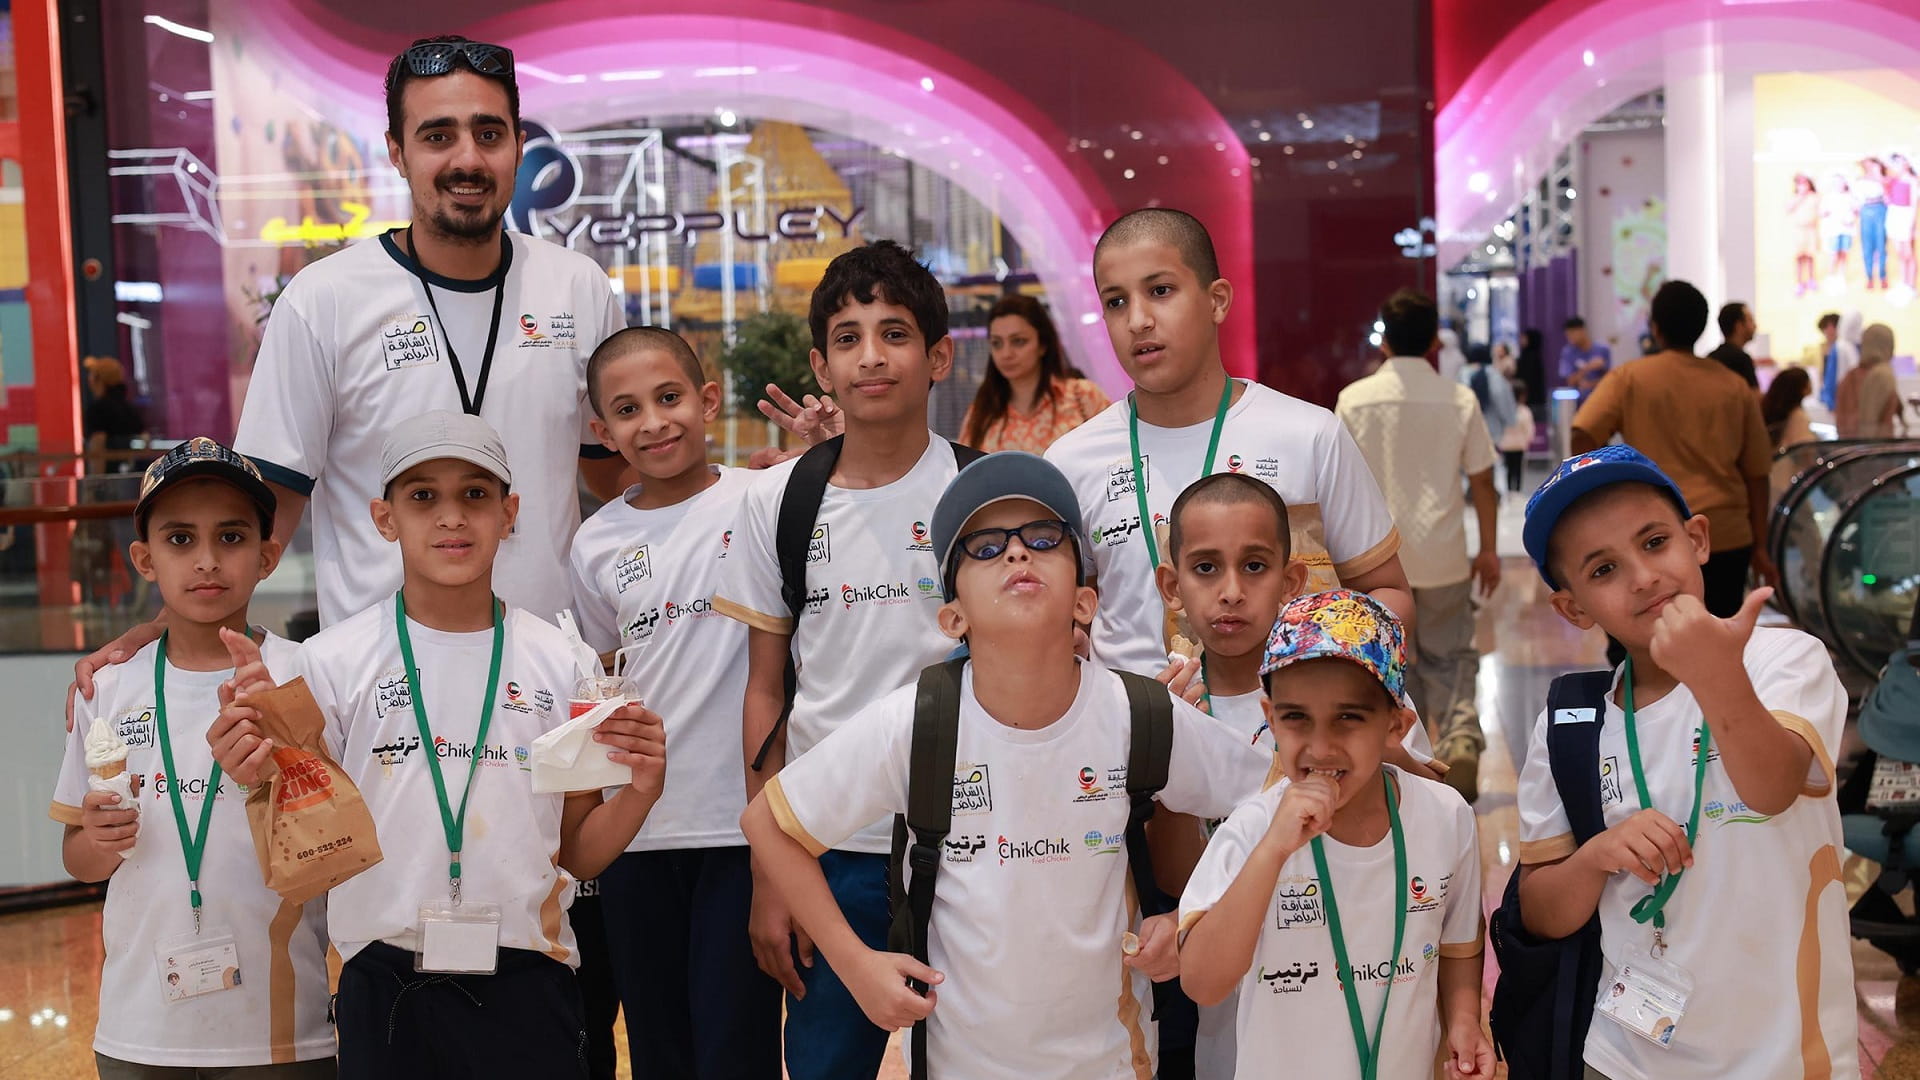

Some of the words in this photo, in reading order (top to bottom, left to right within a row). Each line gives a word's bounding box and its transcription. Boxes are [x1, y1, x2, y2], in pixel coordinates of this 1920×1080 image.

[547, 207, 865, 249] YEPPLEY
[385, 321, 426, 338] صيف
[388, 336, 431, 351] الشارقة
[393, 346, 434, 366] الرياضي
[1102, 516, 1140, 540] ترتيب
[843, 583, 909, 604] ChikChik
[120, 711, 151, 726] صيف
[125, 734, 151, 746] الرياض
[372, 736, 420, 758] ترتيب
[276, 768, 332, 805] KING
[953, 785, 985, 799] الشارق
[1727, 802, 1747, 813] WE
[998, 838, 1071, 858] ChikChik
[1280, 883, 1317, 897] صيف
[1281, 898, 1319, 911] الشارقة
[1284, 910, 1322, 926] الرياضي
[1263, 962, 1319, 987] ترتيب
[1273, 985, 1302, 994] للسياحة
